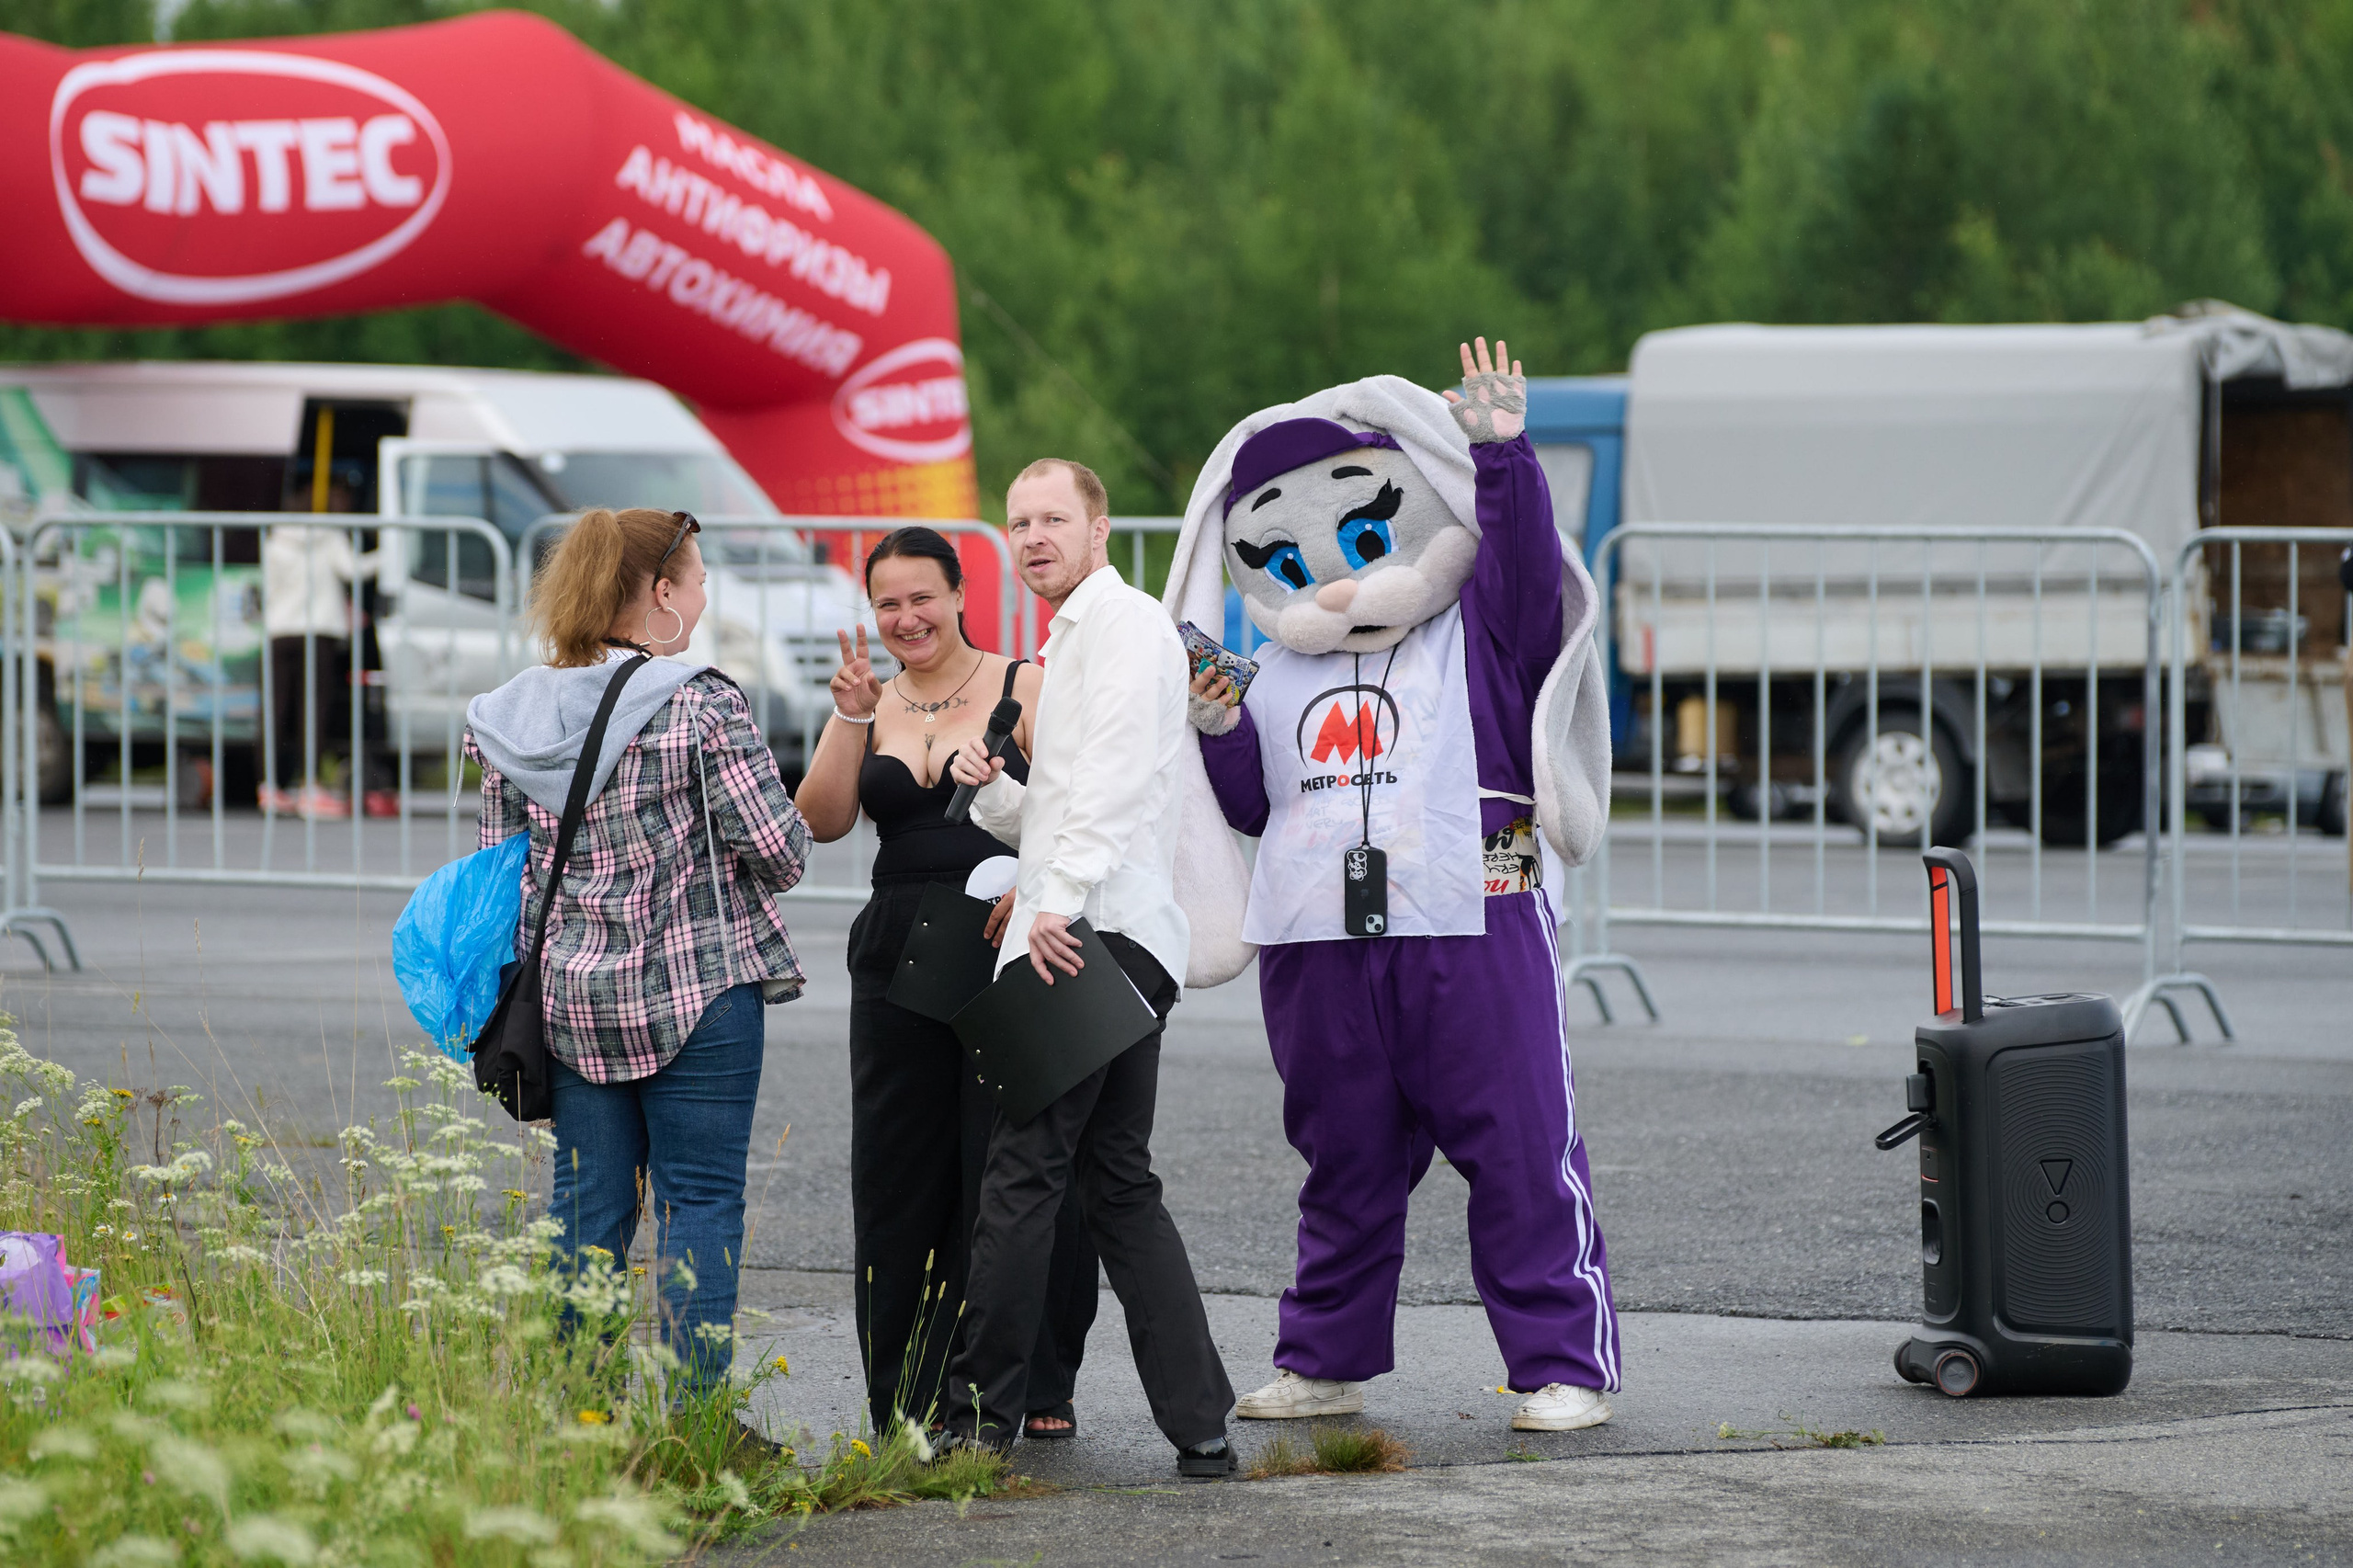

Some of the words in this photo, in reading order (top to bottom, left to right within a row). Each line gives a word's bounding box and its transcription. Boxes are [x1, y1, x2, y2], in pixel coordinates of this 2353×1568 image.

[81, 109, 423, 216] SINTEC
[616, 144, 892, 316] АНТИФРИЗЫ
[582, 217, 863, 378] АВТОХИМИЯ
[1301, 771, 1398, 792] МЕТРОСЕТЬ
